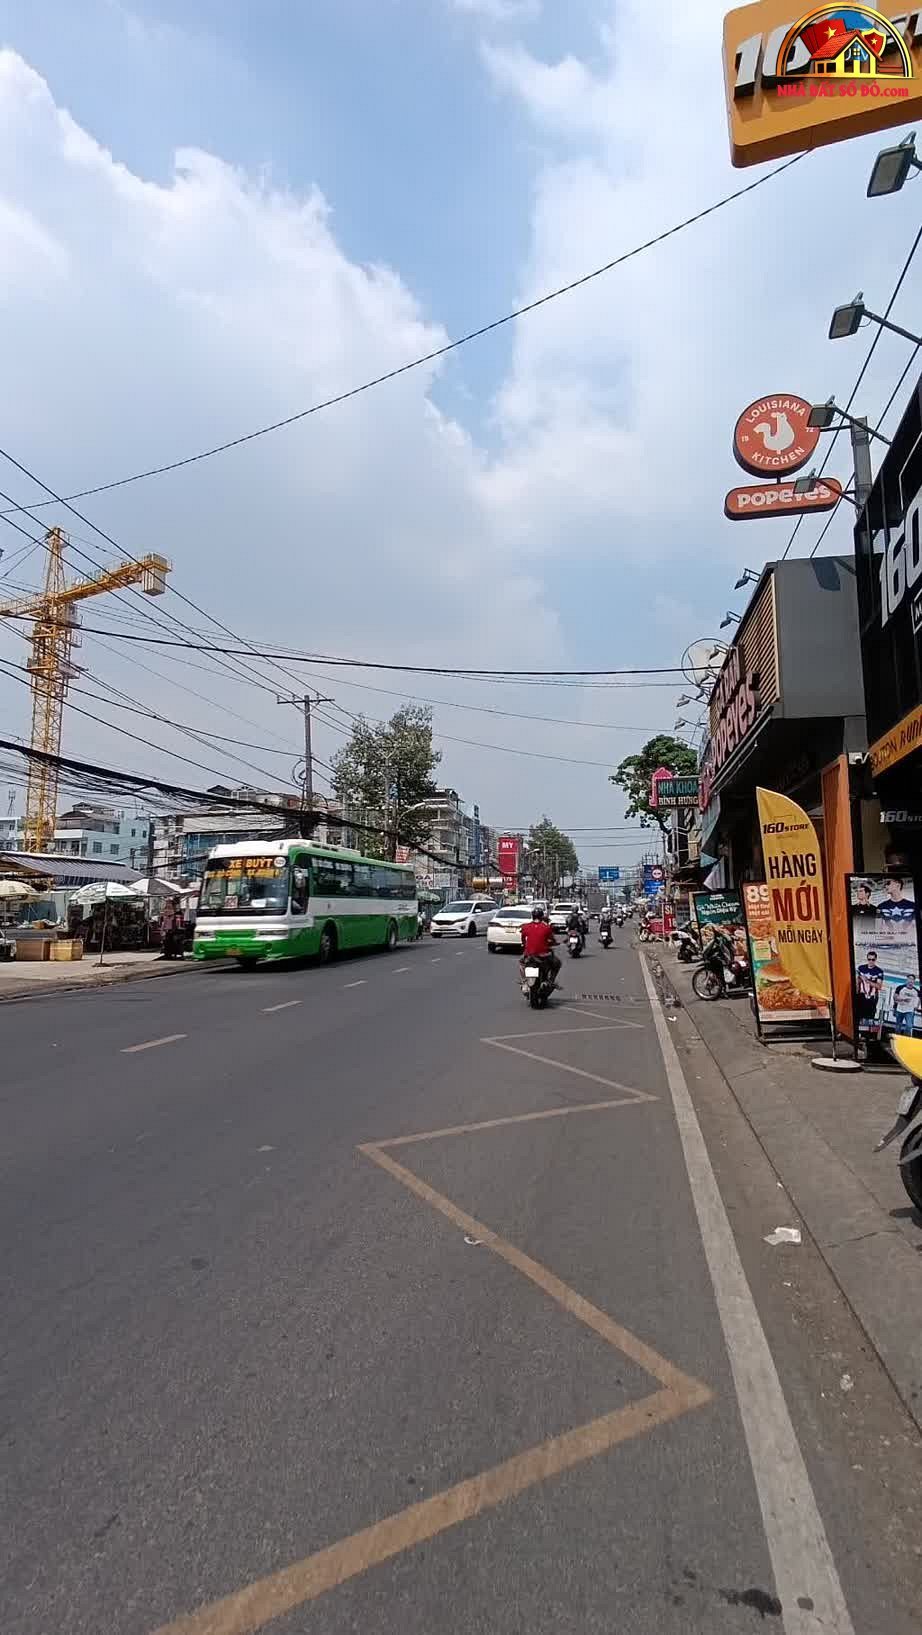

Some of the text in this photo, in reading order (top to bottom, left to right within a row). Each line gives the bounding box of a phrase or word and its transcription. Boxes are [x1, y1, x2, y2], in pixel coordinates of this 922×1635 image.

[746, 400, 806, 423] LOUISIANA
[751, 446, 806, 465] KITCHEN
[230, 859, 243, 868] XE
[768, 851, 817, 879] HÀNG
[772, 880, 821, 922] MỚI
[778, 924, 823, 944] MỖI NGÀY
